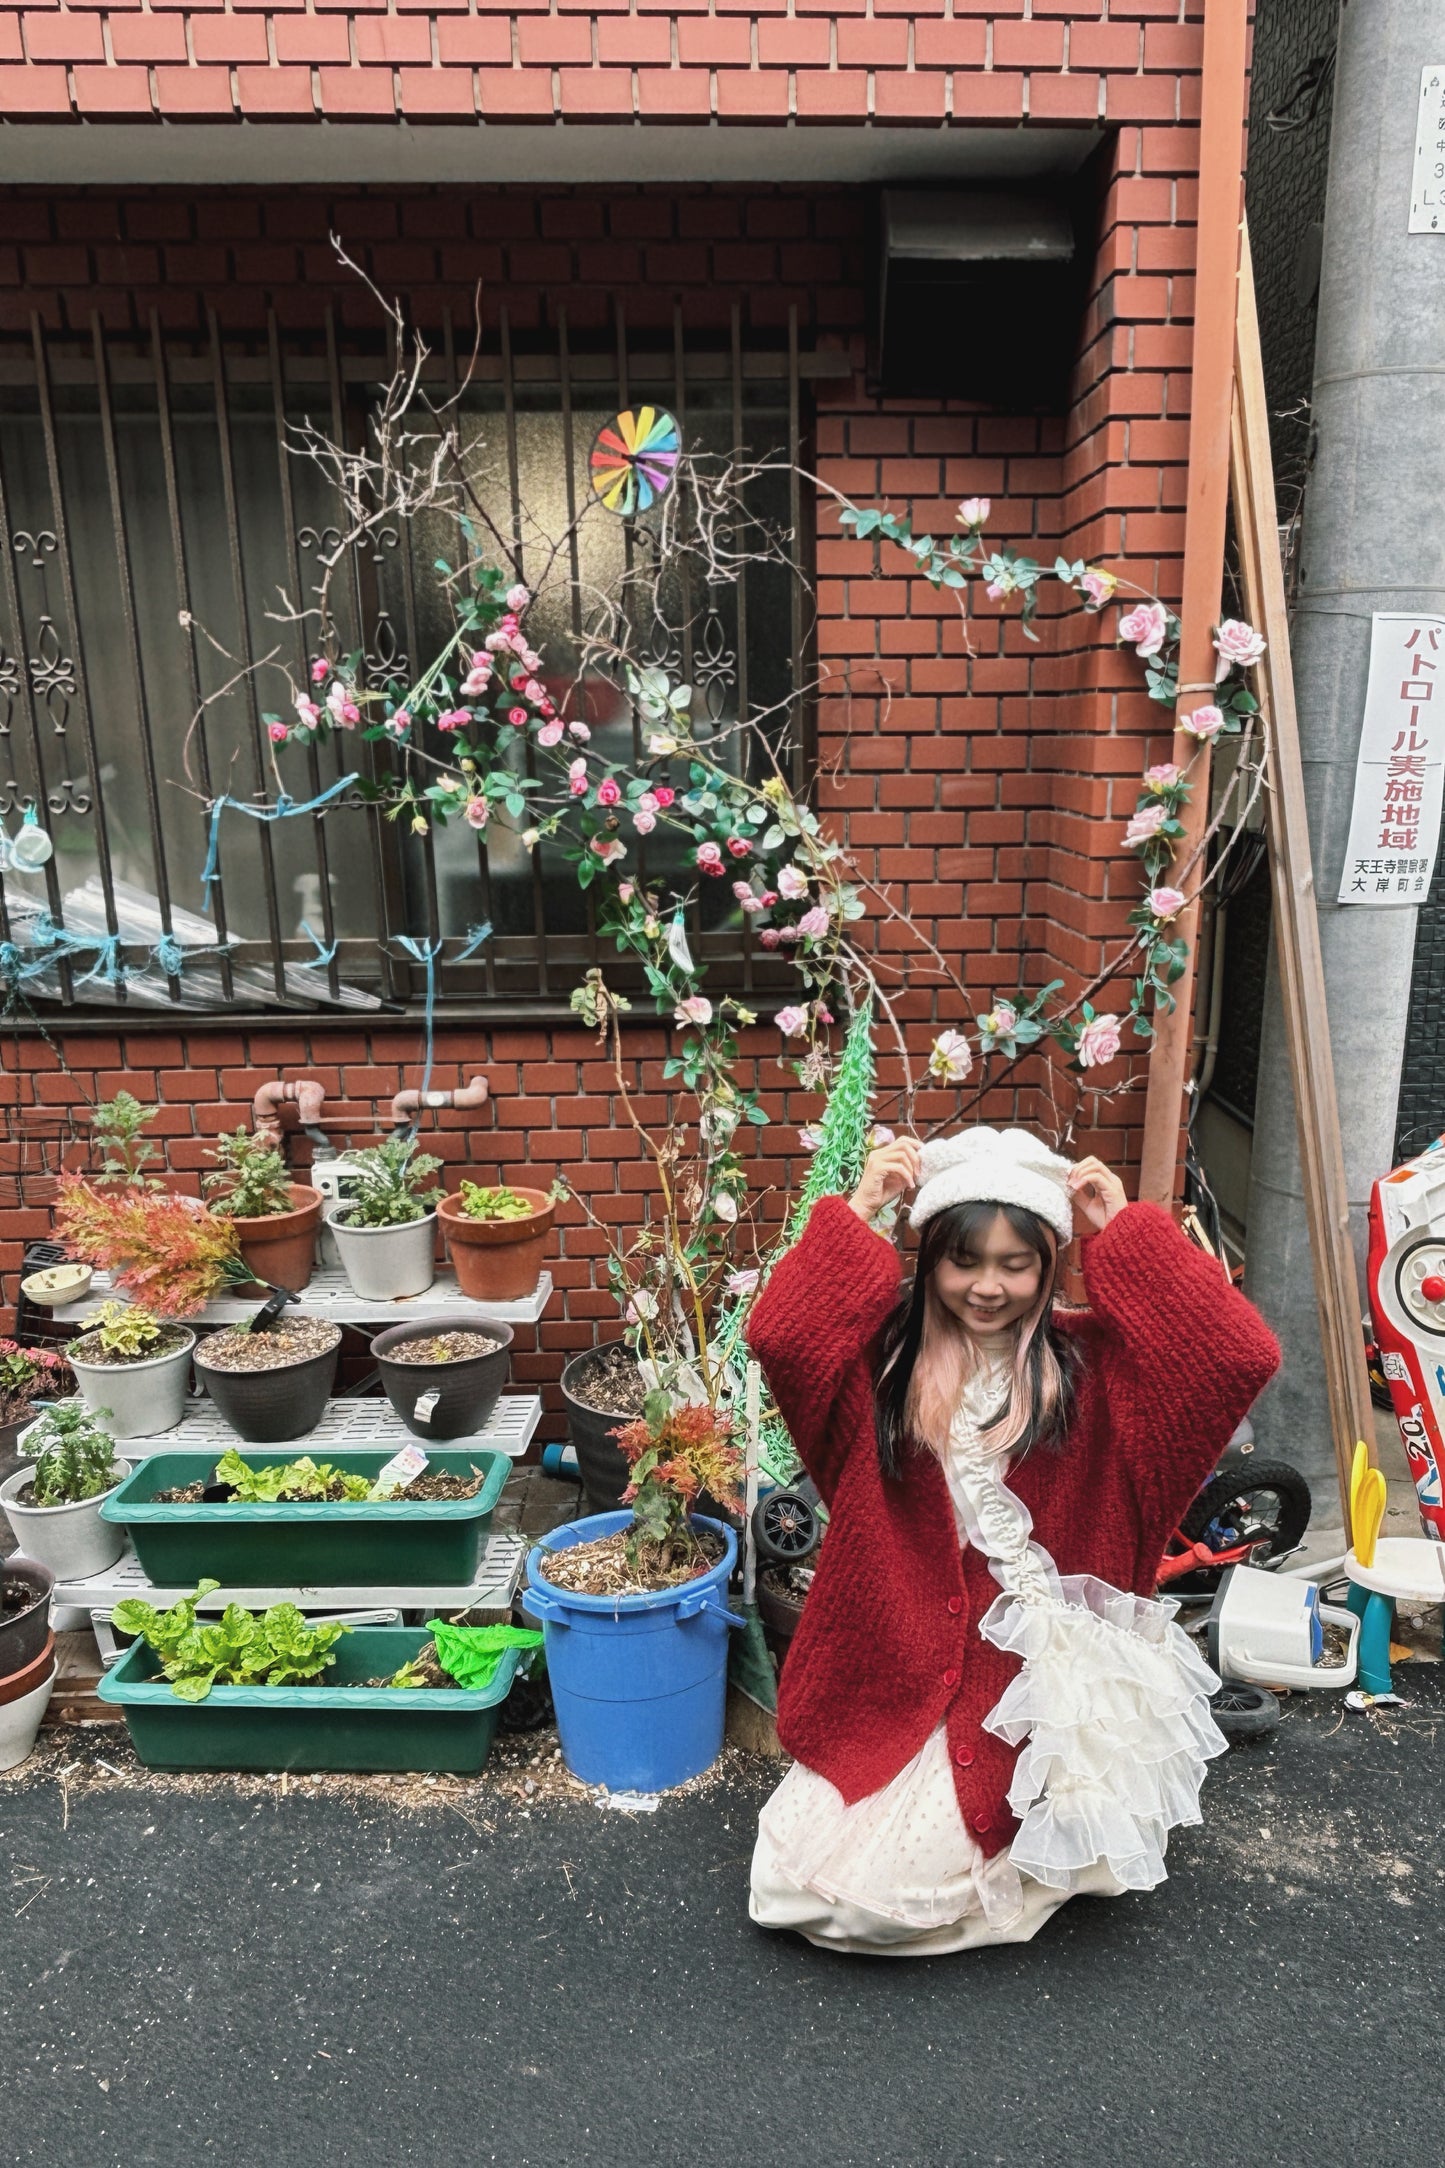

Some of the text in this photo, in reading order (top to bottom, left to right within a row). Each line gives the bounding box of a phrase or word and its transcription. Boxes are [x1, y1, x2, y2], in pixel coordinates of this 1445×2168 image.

[1378, 628, 1441, 850] パトロール実施地域
